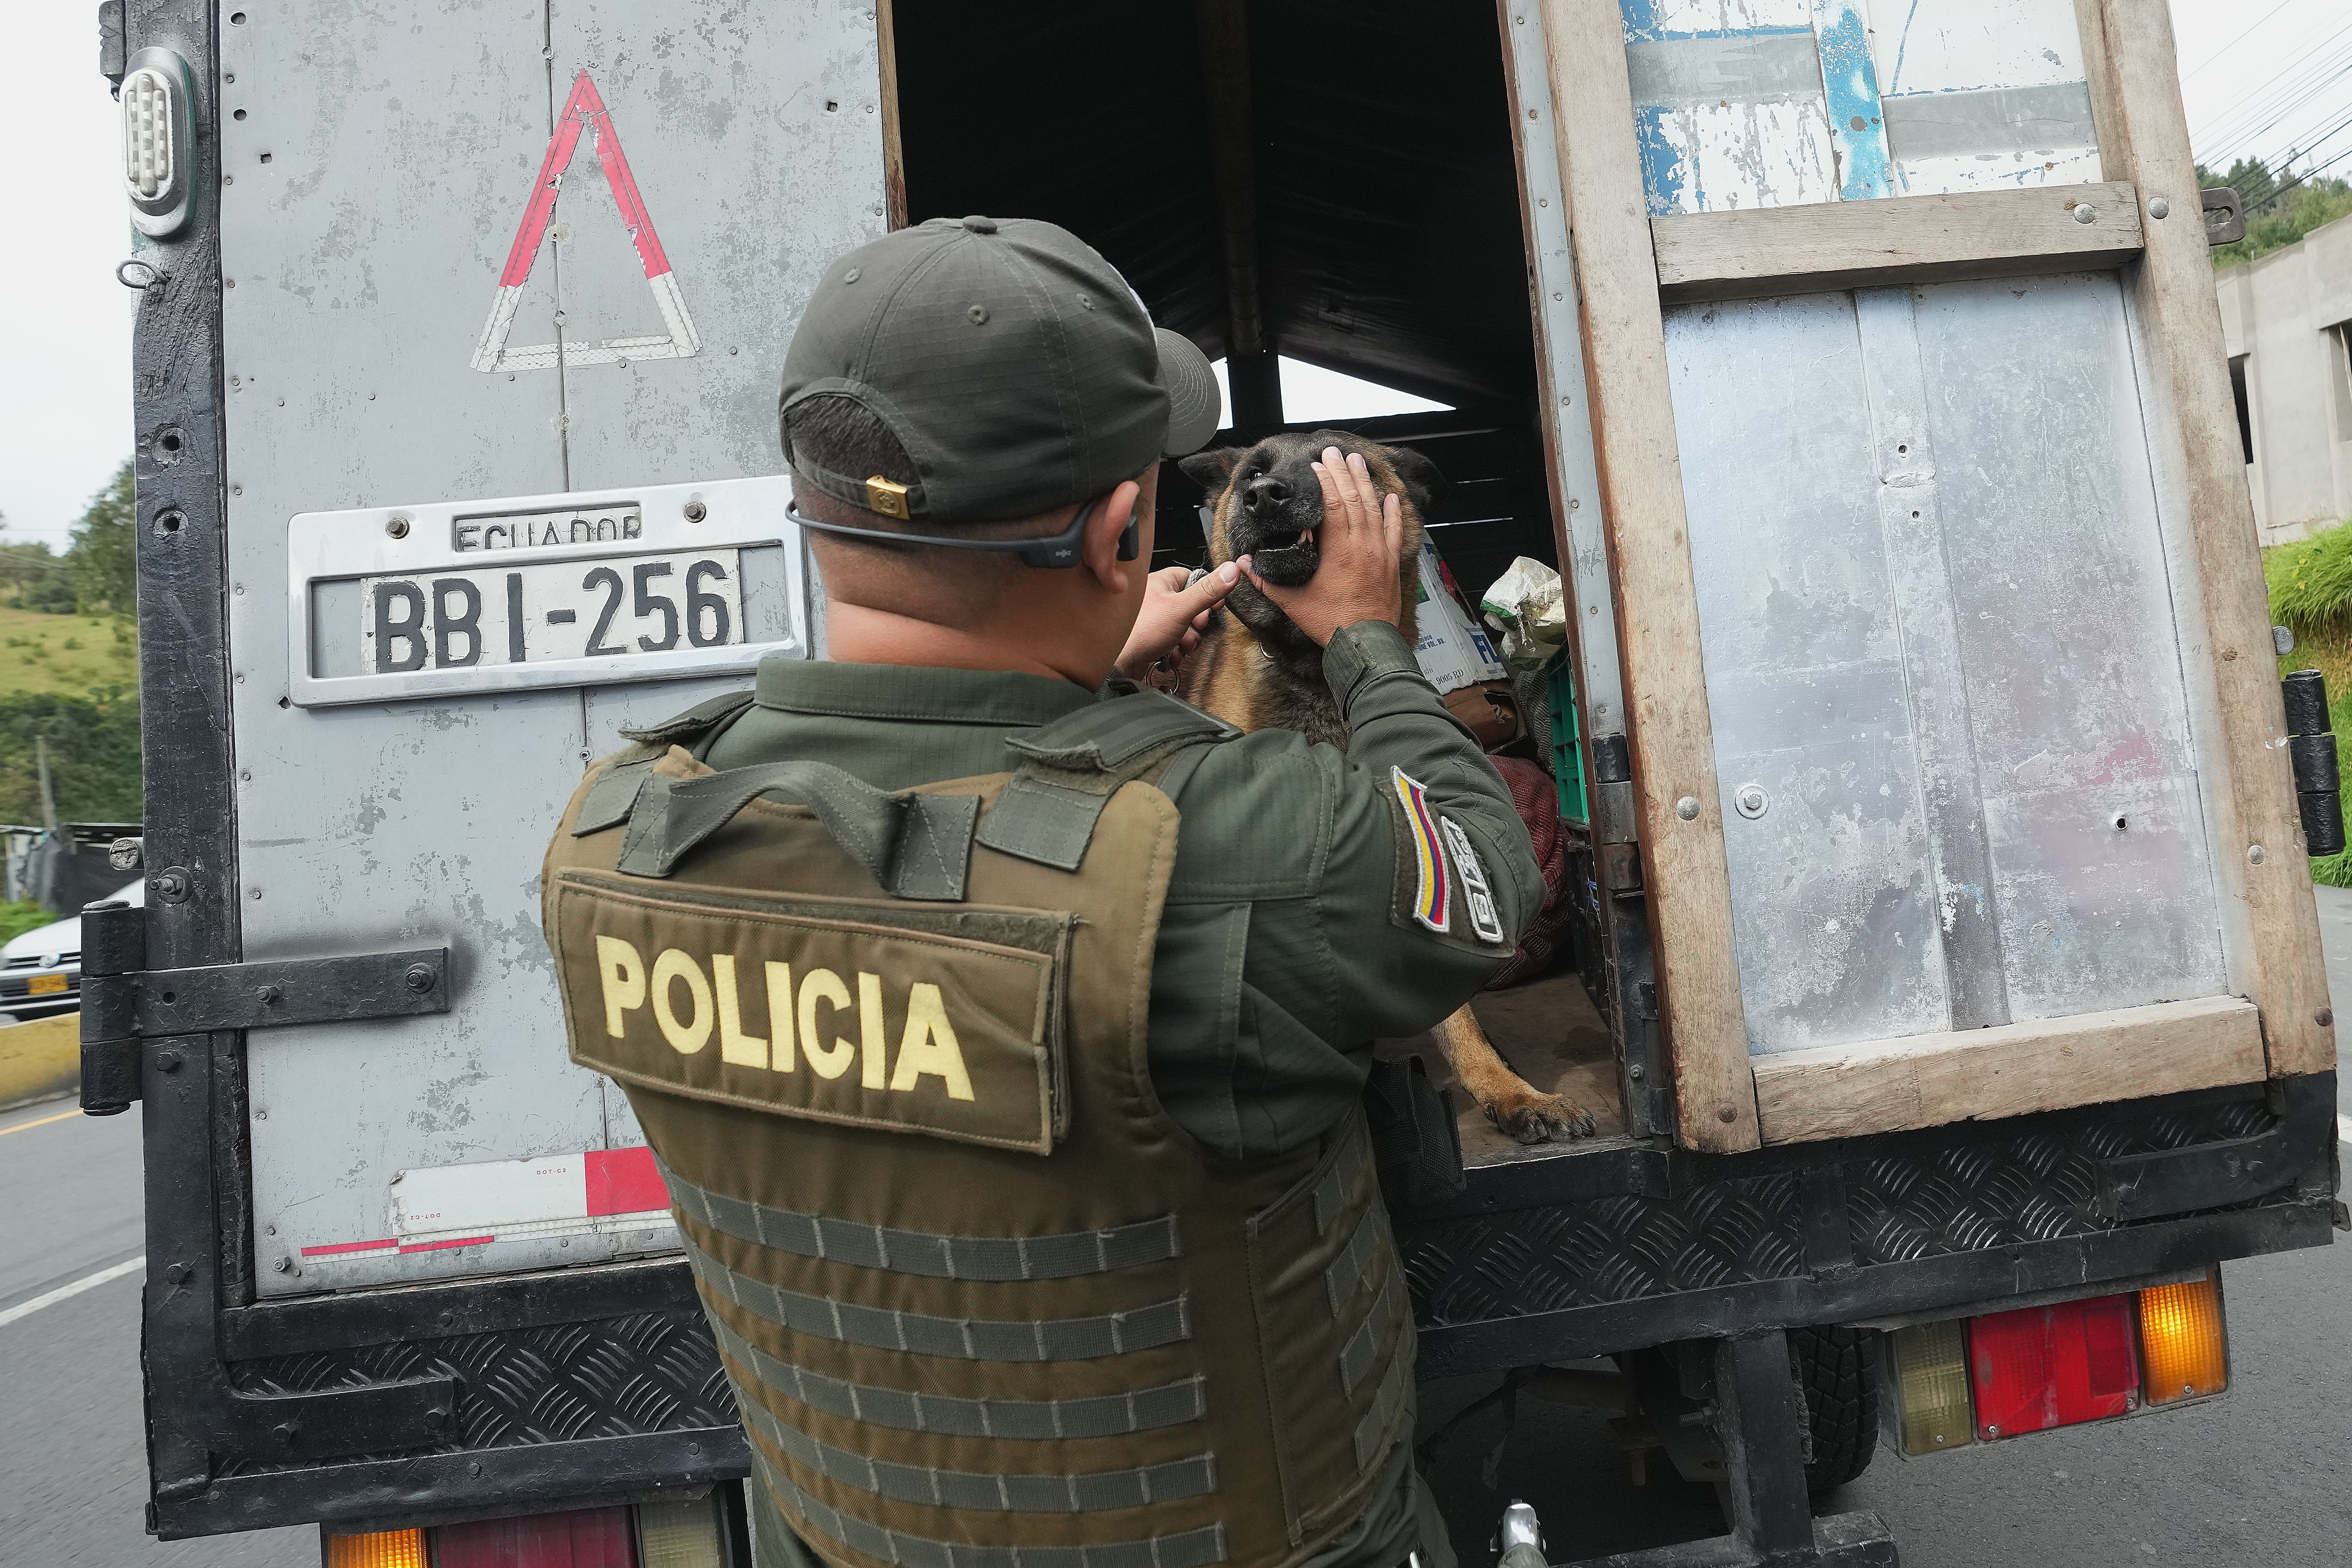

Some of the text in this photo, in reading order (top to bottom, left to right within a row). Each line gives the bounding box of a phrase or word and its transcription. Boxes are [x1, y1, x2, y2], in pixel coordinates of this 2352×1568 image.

[1436, 669, 1464, 685] 9005 RD
[595, 935, 976, 1102] POLICIA
